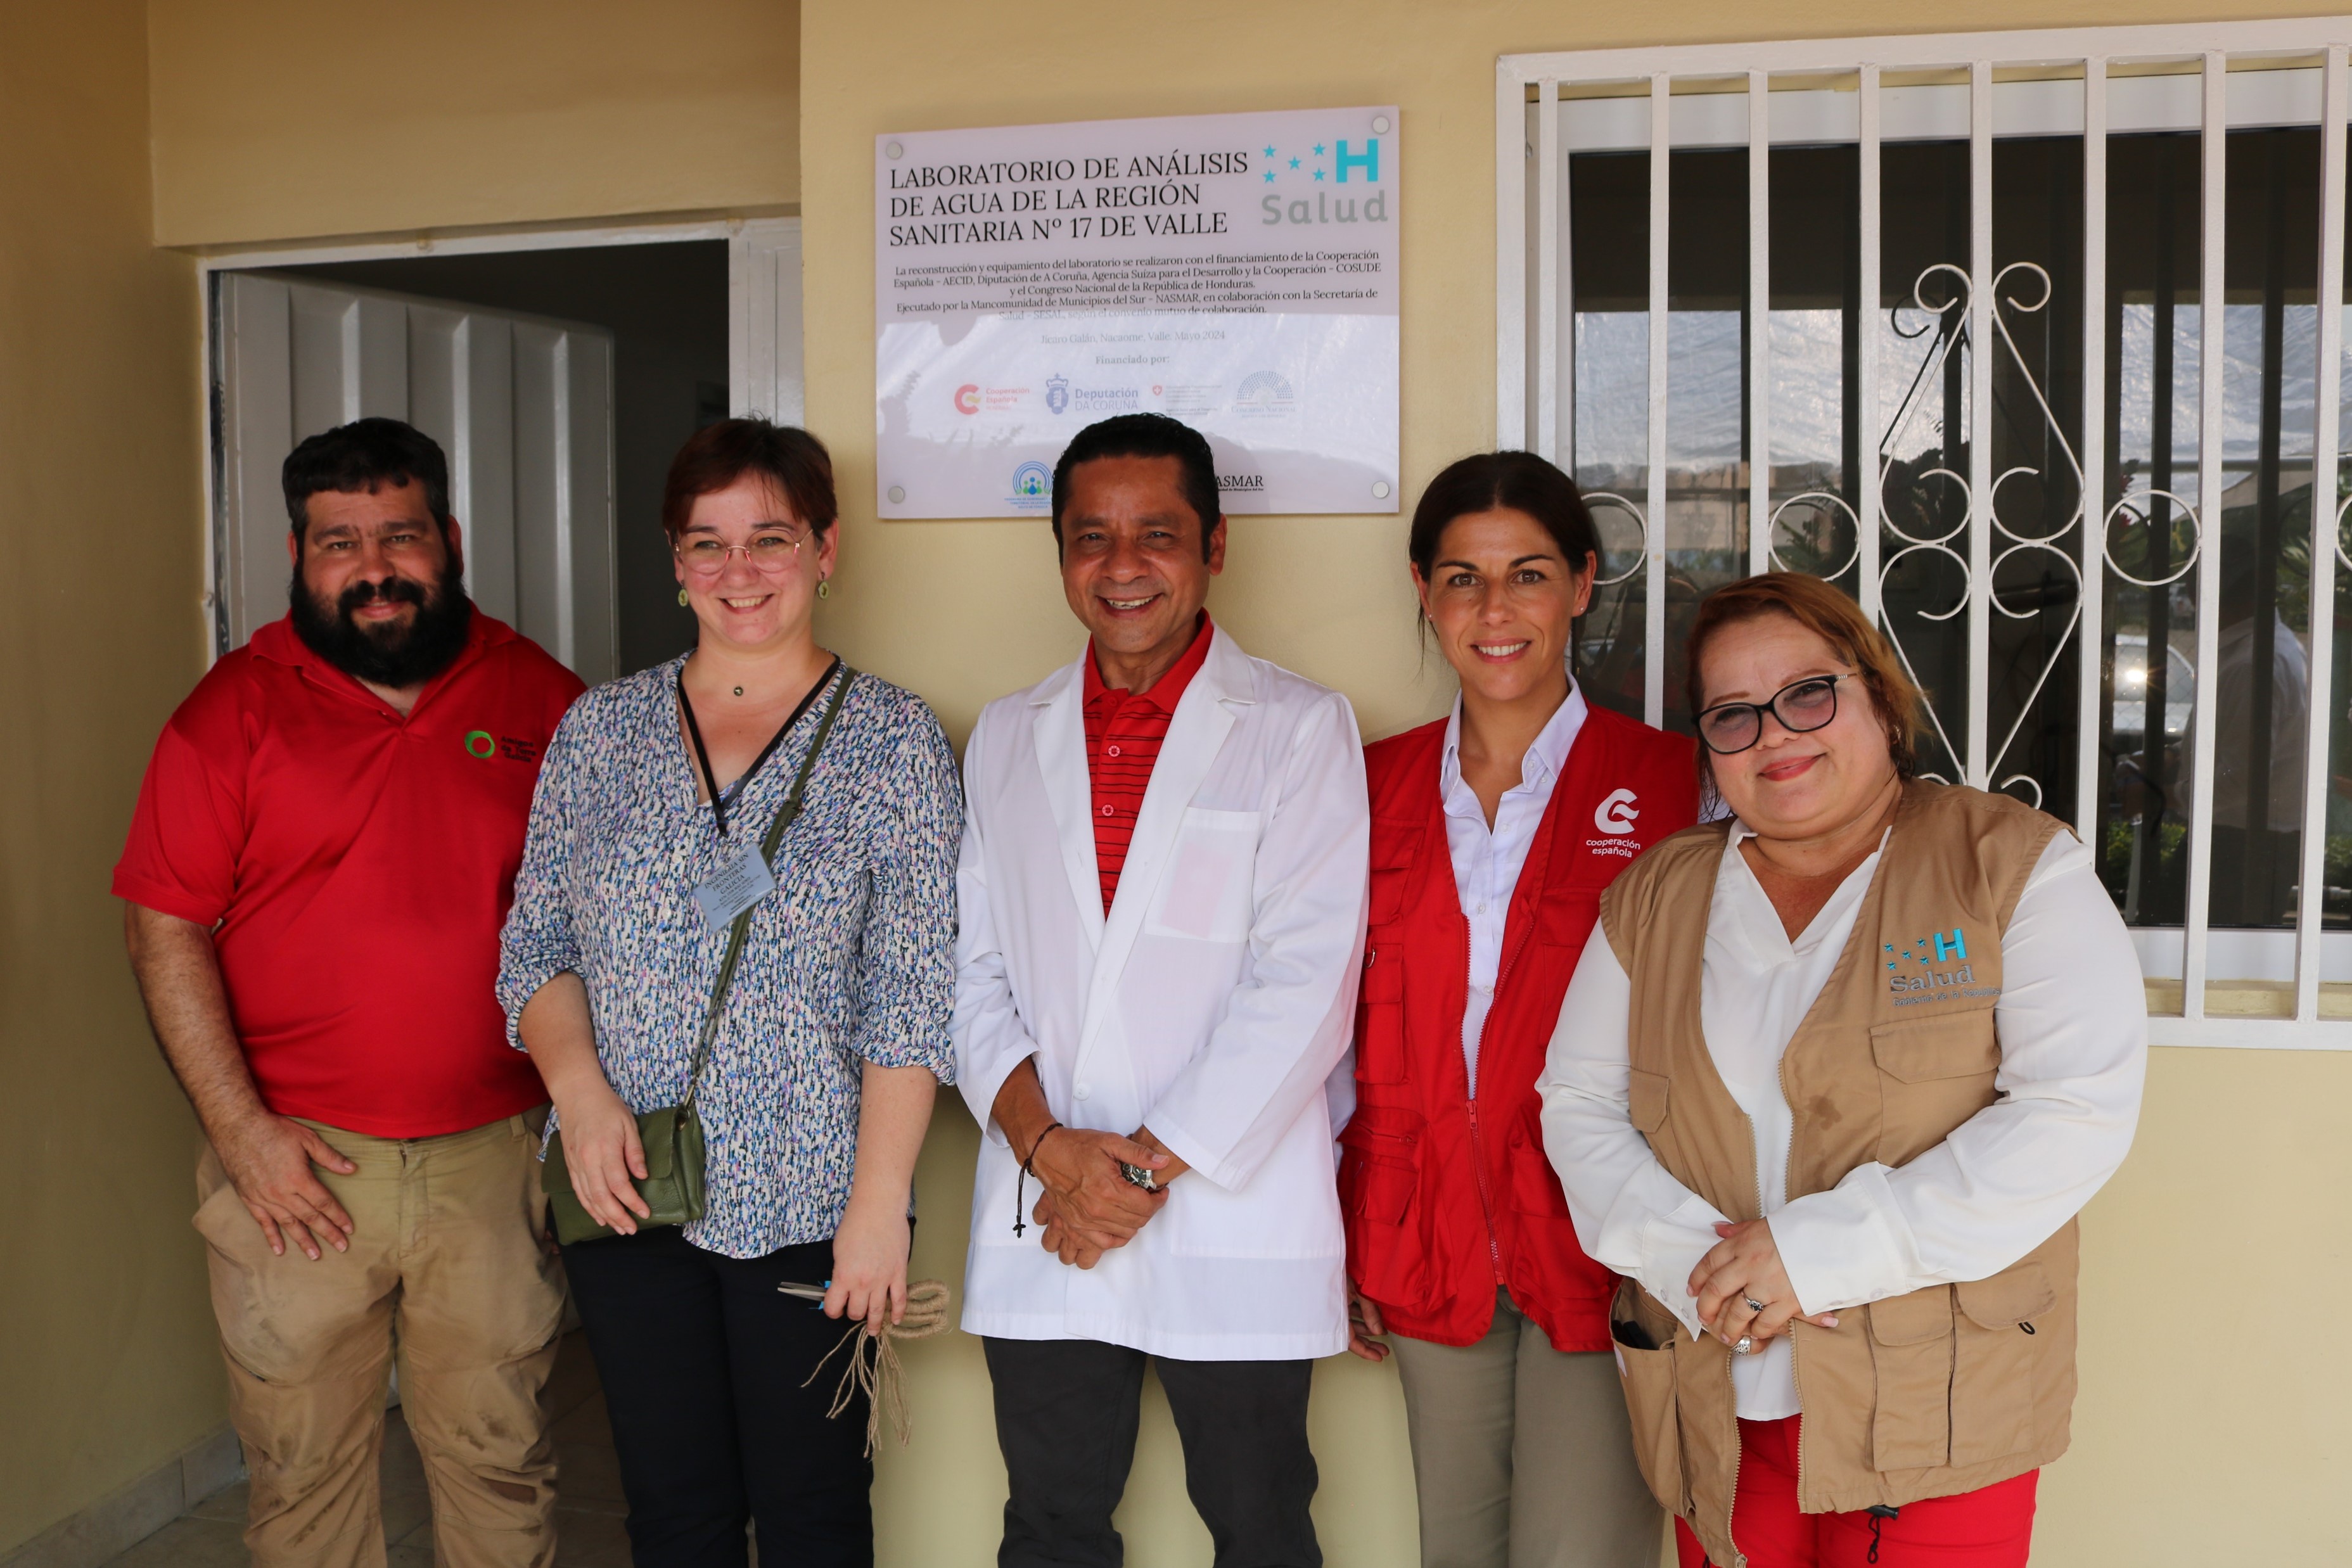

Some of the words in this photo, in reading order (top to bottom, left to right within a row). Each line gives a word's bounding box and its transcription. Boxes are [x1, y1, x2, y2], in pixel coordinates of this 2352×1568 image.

[890, 160, 1075, 189] LABORATORIO
[1084, 158, 1119, 179] DE
[1127, 149, 1248, 177] ANÁLISIS
[1336, 138, 1378, 183] H
[890, 196, 923, 217] DE
[931, 193, 1004, 215] AGUA
[1013, 190, 1046, 212] DE
[1056, 188, 1087, 210] LA
[1096, 179, 1200, 208] REGIÓN
[1262, 190, 1388, 225] Salud
[890, 220, 1024, 246] SANITARIA
[1070, 217, 1092, 238] 17
[1101, 215, 1135, 237] DE
[1144, 212, 1227, 236] VALLE
[895, 266, 906, 276] La
[908, 262, 977, 275] reconstrucción
[987, 260, 1051, 273] equipamiento
[1052, 259, 1066, 269] del
[1069, 257, 1121, 269] laboratorio
[1135, 256, 1183, 265] realizaron
[1205, 254, 1214, 264] el
[1216, 252, 1289, 264] financiamiento
[1291, 252, 1303, 261] de
[1305, 251, 1314, 261] la
[1316, 249, 1379, 262] Cooperación
[893, 277, 934, 290] Española
[943, 276, 976, 286] AECID,
[978, 273, 1028, 286] Diputación
[1030, 272, 1042, 283] de
[1044, 273, 1051, 283] A
[1052, 271, 1090, 283] Coruña,
[1092, 270, 1129, 282] Agencia
[1159, 271, 1180, 281] para
[1182, 267, 1191, 277] el
[1193, 266, 1243, 277] Desarrollo
[1253, 265, 1262, 275] la
[1263, 264, 1326, 277] Cooperación
[1336, 262, 1381, 273] COSUDE
[1009, 288, 1016, 298] y
[1017, 285, 1026, 295] el
[1027, 284, 1073, 296] Congreso
[1075, 282, 1116, 293] Nacional
[1118, 281, 1130, 291] de
[1132, 281, 1141, 291] la
[1142, 279, 1189, 293] República
[1191, 279, 1203, 289] de
[1205, 279, 1255, 290] Honduras.
[897, 302, 941, 313] Ejecutado
[943, 303, 958, 313] por
[961, 300, 969, 310] la
[970, 298, 1043, 309] Mancomunidad
[1045, 297, 1057, 307] de
[1059, 296, 1111, 308] Municipios
[1113, 295, 1128, 305] del
[1129, 295, 1146, 304] Sur
[1156, 293, 1201, 304] NASMAR,
[1218, 290, 1281, 302] colaboración
[1303, 290, 1312, 299] la
[1313, 289, 1364, 299] Secretaría
[1365, 288, 1377, 298] de
[999, 311, 1024, 321] Salud
[1033, 310, 1066, 319] SESAL,
[1068, 309, 1095, 320] según
[1098, 309, 1107, 317] el
[1108, 307, 1152, 317] convenio
[1154, 308, 1186, 316] mutuo
[1188, 305, 1200, 315] de
[1202, 303, 1267, 314] colaboración.
[1040, 335, 1068, 344] Jícaro
[1070, 333, 1097, 344] Galán,
[1100, 332, 1146, 343] Nacaome,
[1174, 331, 1200, 343] Mayo
[1202, 330, 1225, 340] 2024
[1096, 355, 1147, 364] Financiado
[1151, 355, 1170, 366] por:
[986, 387, 1030, 396] Cooperación
[986, 395, 1018, 404] Española
[1075, 388, 1139, 403] Deputación
[1075, 400, 1091, 411] DA
[1216, 475, 1263, 487] ASMAR
[1586, 838, 1640, 850] cooperación
[1592, 846, 1632, 858] española
[738, 852, 748, 862] SIN
[712, 864, 746, 891] FRONTERAS
[720, 874, 745, 895] GALICIA
[1933, 928, 1967, 962] H
[1890, 964, 1976, 993] Salud
